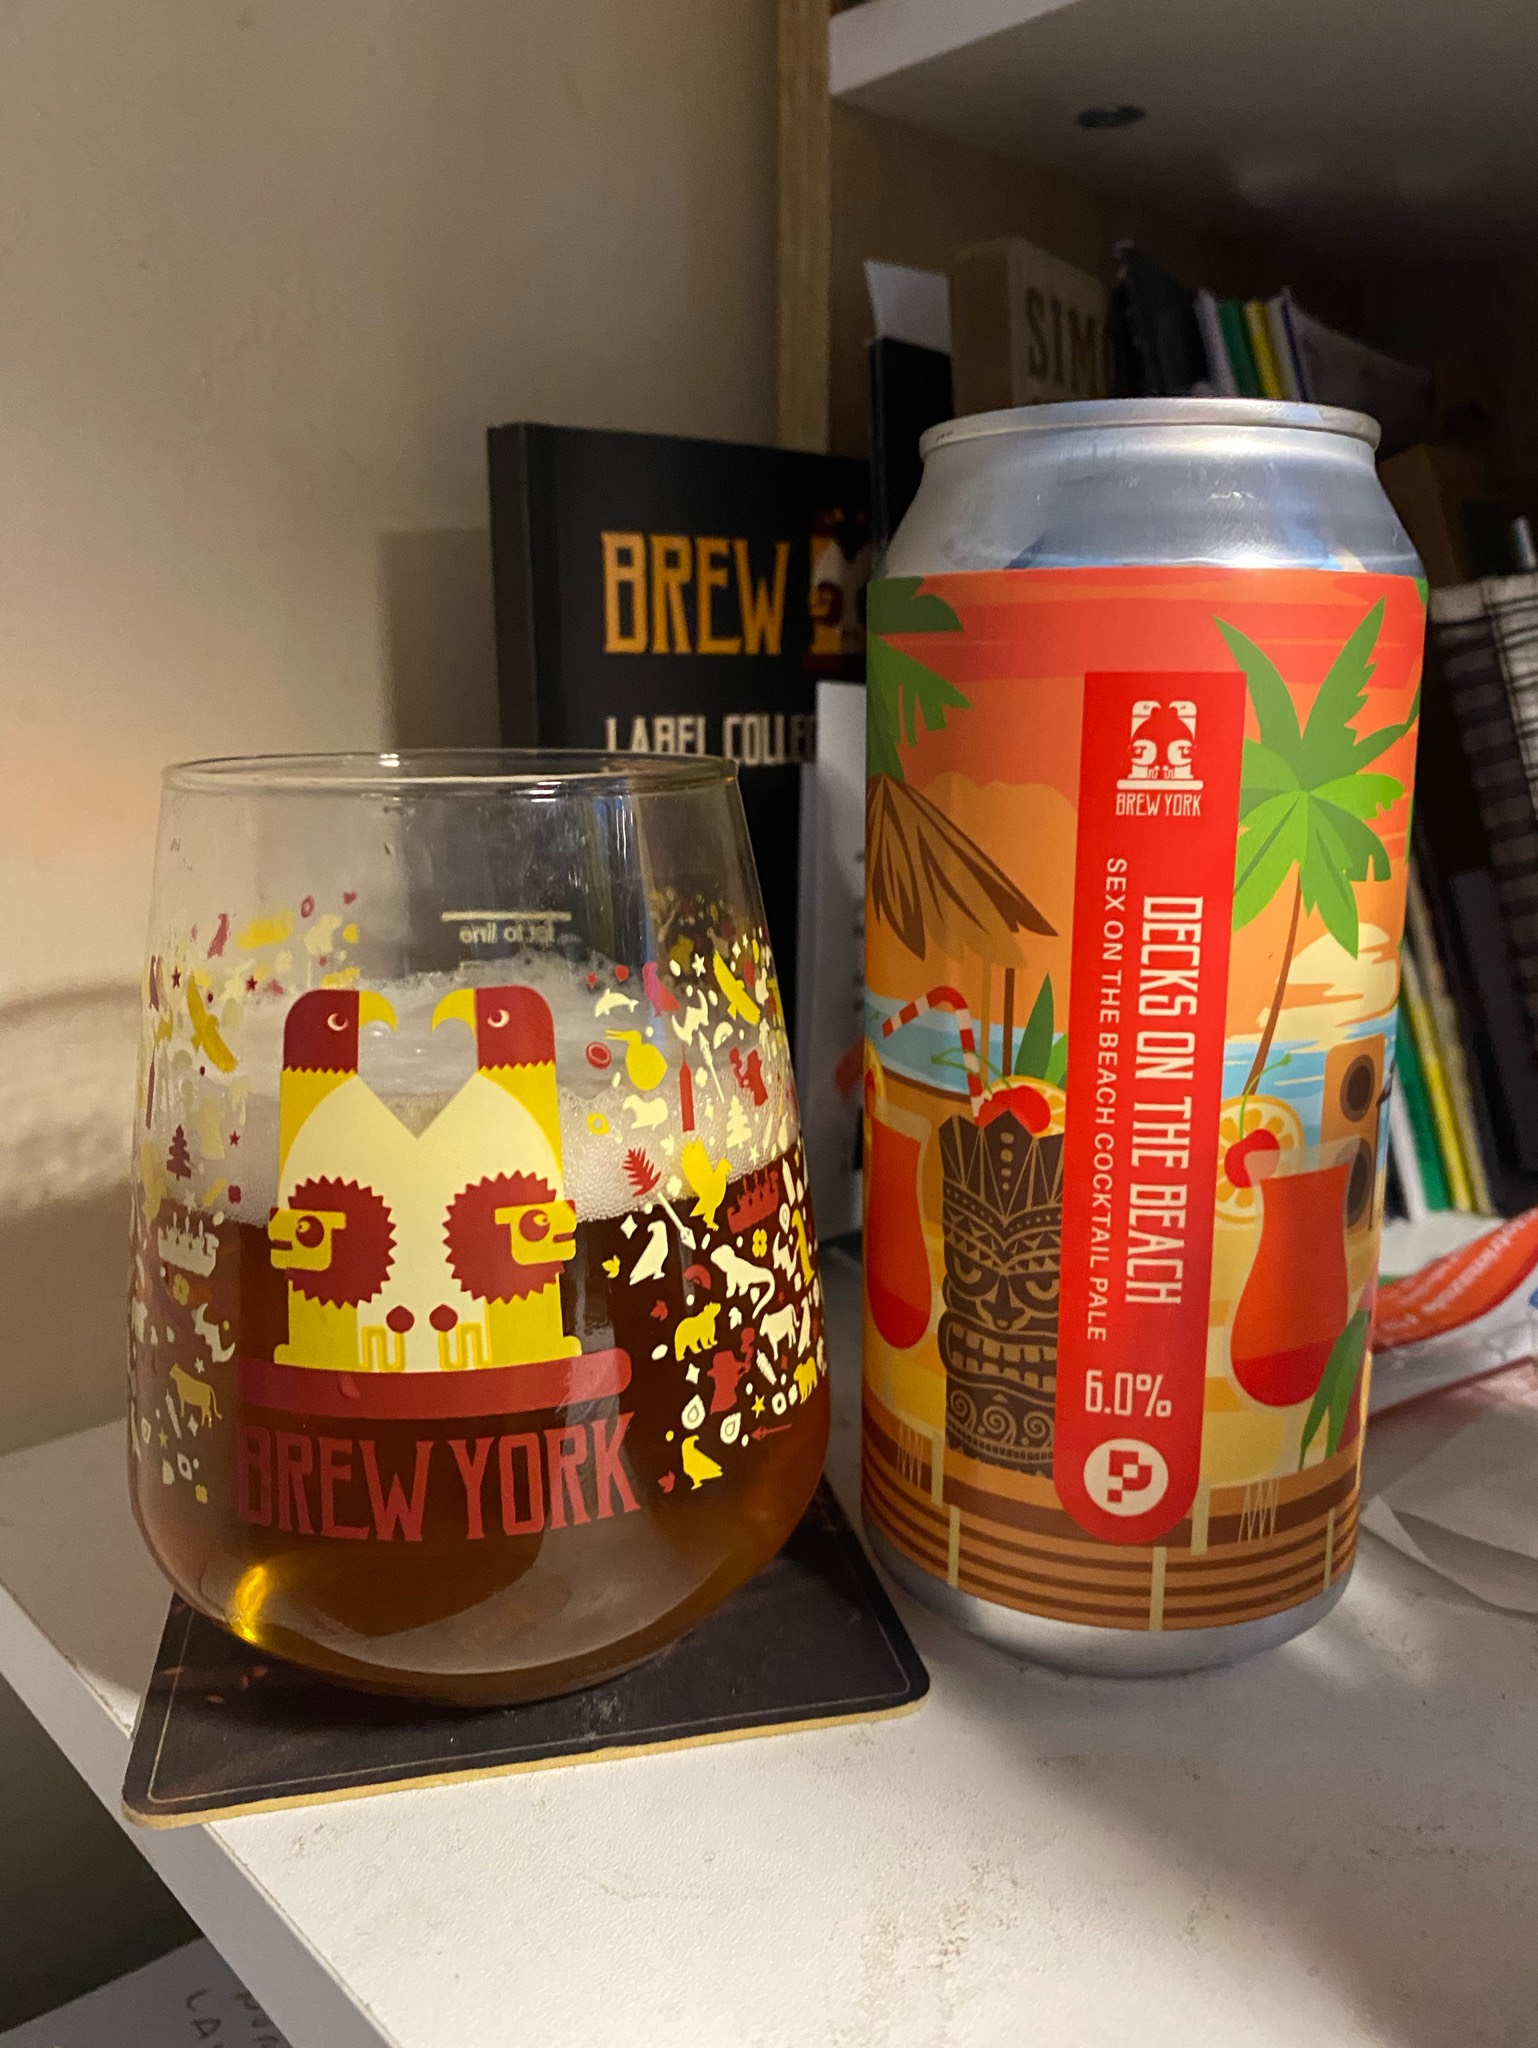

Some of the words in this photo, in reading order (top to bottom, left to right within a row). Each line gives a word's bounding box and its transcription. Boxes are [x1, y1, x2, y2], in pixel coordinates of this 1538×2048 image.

[601, 531, 790, 655] BREW
[1115, 792, 1161, 817] BREW
[1164, 792, 1203, 817] YORK
[1104, 857, 1129, 912] SEX
[1102, 919, 1125, 962] ON
[1137, 895, 1205, 1017] DECKS
[1099, 969, 1122, 1025] THE
[1096, 1032, 1119, 1125] BEACH
[1134, 1030, 1196, 1081] ON
[1130, 1095, 1193, 1170] THE
[1089, 1132, 1115, 1269] COCKTAIL
[1124, 1182, 1189, 1305] BEACH
[1087, 1276, 1109, 1342] PALE
[1084, 1368, 1173, 1418] 6.0%
[237, 1424, 435, 1542] BREW
[447, 1411, 642, 1541] YORK
